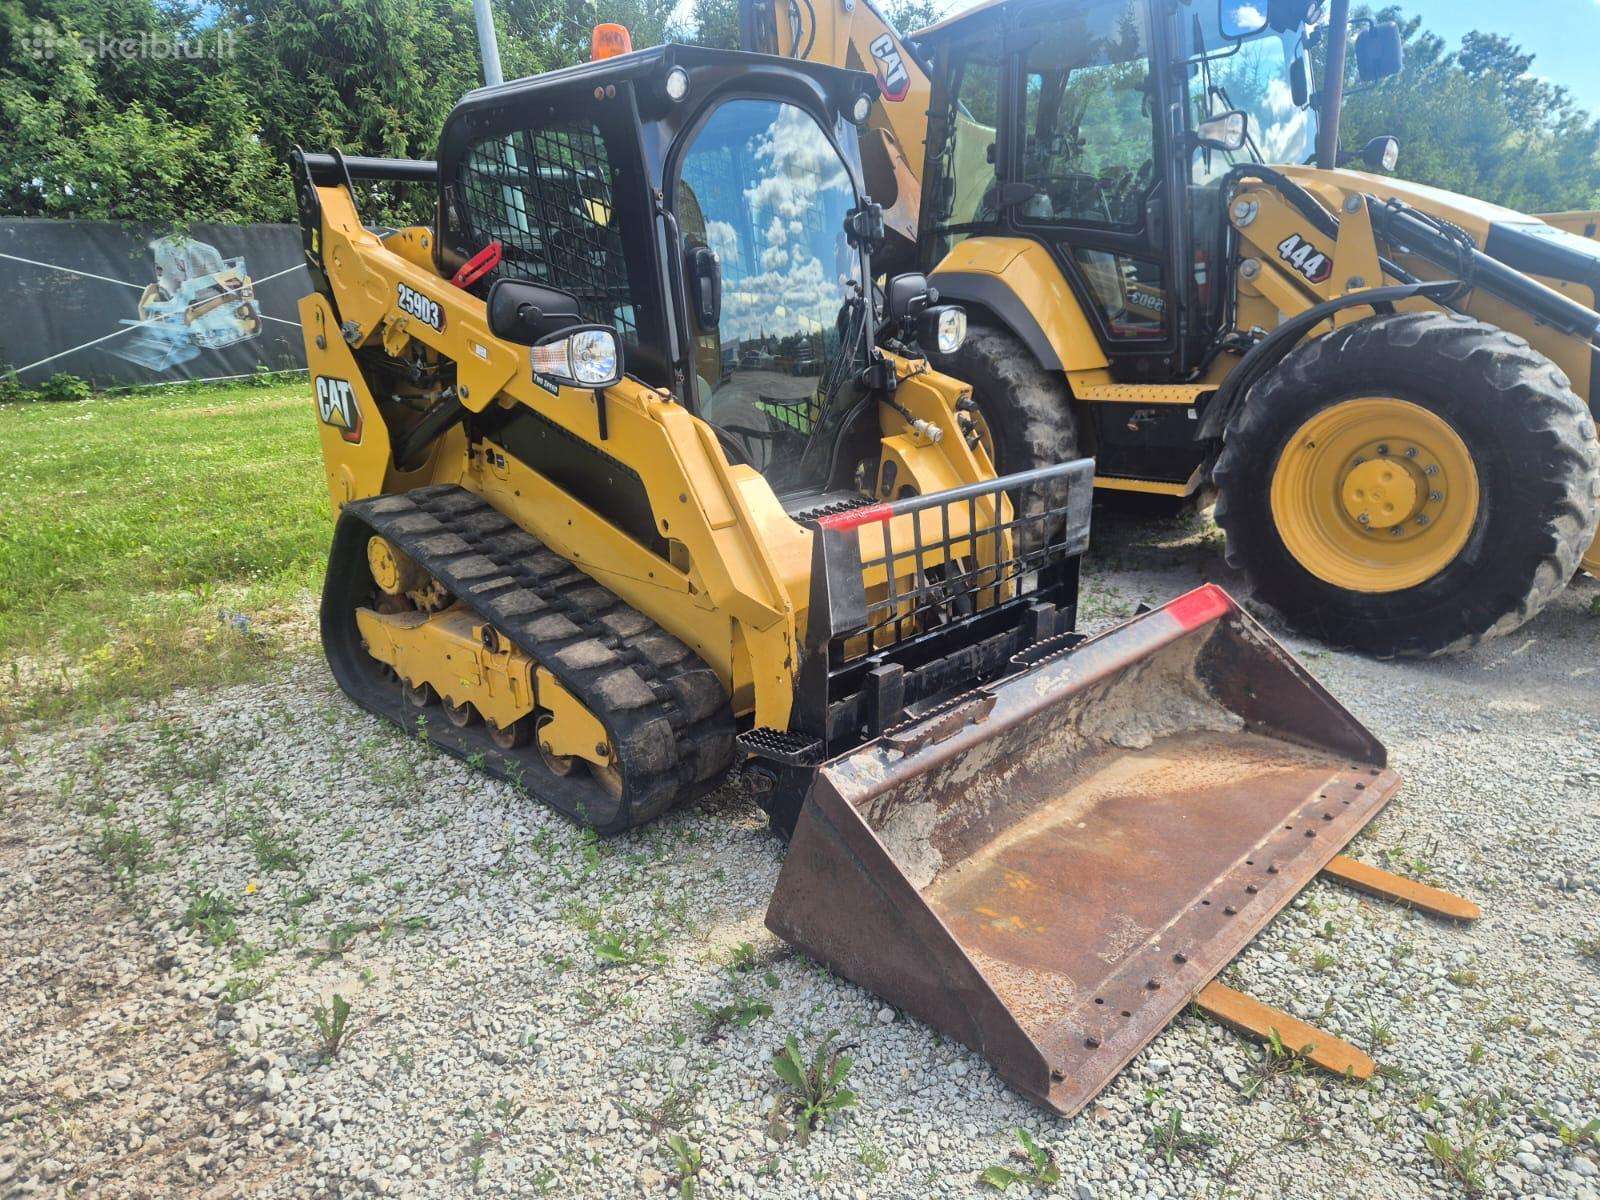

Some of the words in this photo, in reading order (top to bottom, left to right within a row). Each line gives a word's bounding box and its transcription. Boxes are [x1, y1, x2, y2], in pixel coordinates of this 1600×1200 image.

[870, 32, 908, 88] CAT
[1278, 234, 1325, 279] 444
[398, 282, 440, 329] 259D3
[315, 376, 351, 429] CAT
